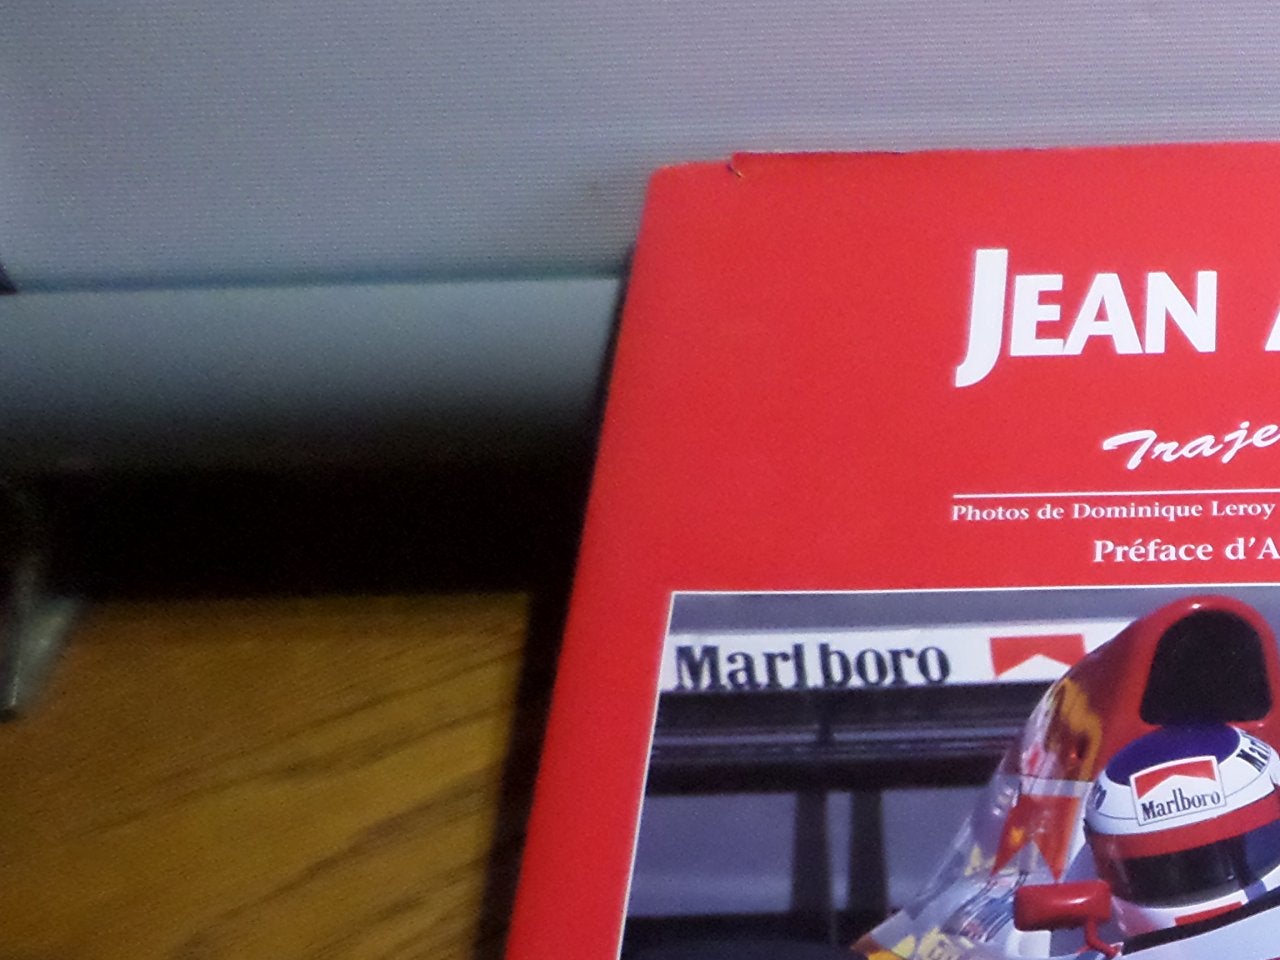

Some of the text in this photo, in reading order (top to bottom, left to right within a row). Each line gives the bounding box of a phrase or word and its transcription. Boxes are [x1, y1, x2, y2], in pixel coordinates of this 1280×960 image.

[955, 248, 1217, 388] JEAN
[952, 504, 1030, 521] Photos
[1037, 503, 1065, 519] de
[1073, 502, 1203, 521] Dominique
[1212, 501, 1275, 520] Leroy
[1093, 538, 1213, 562] Préface
[674, 643, 951, 691] Marlboro
[1140, 788, 1221, 822] Marlboro
